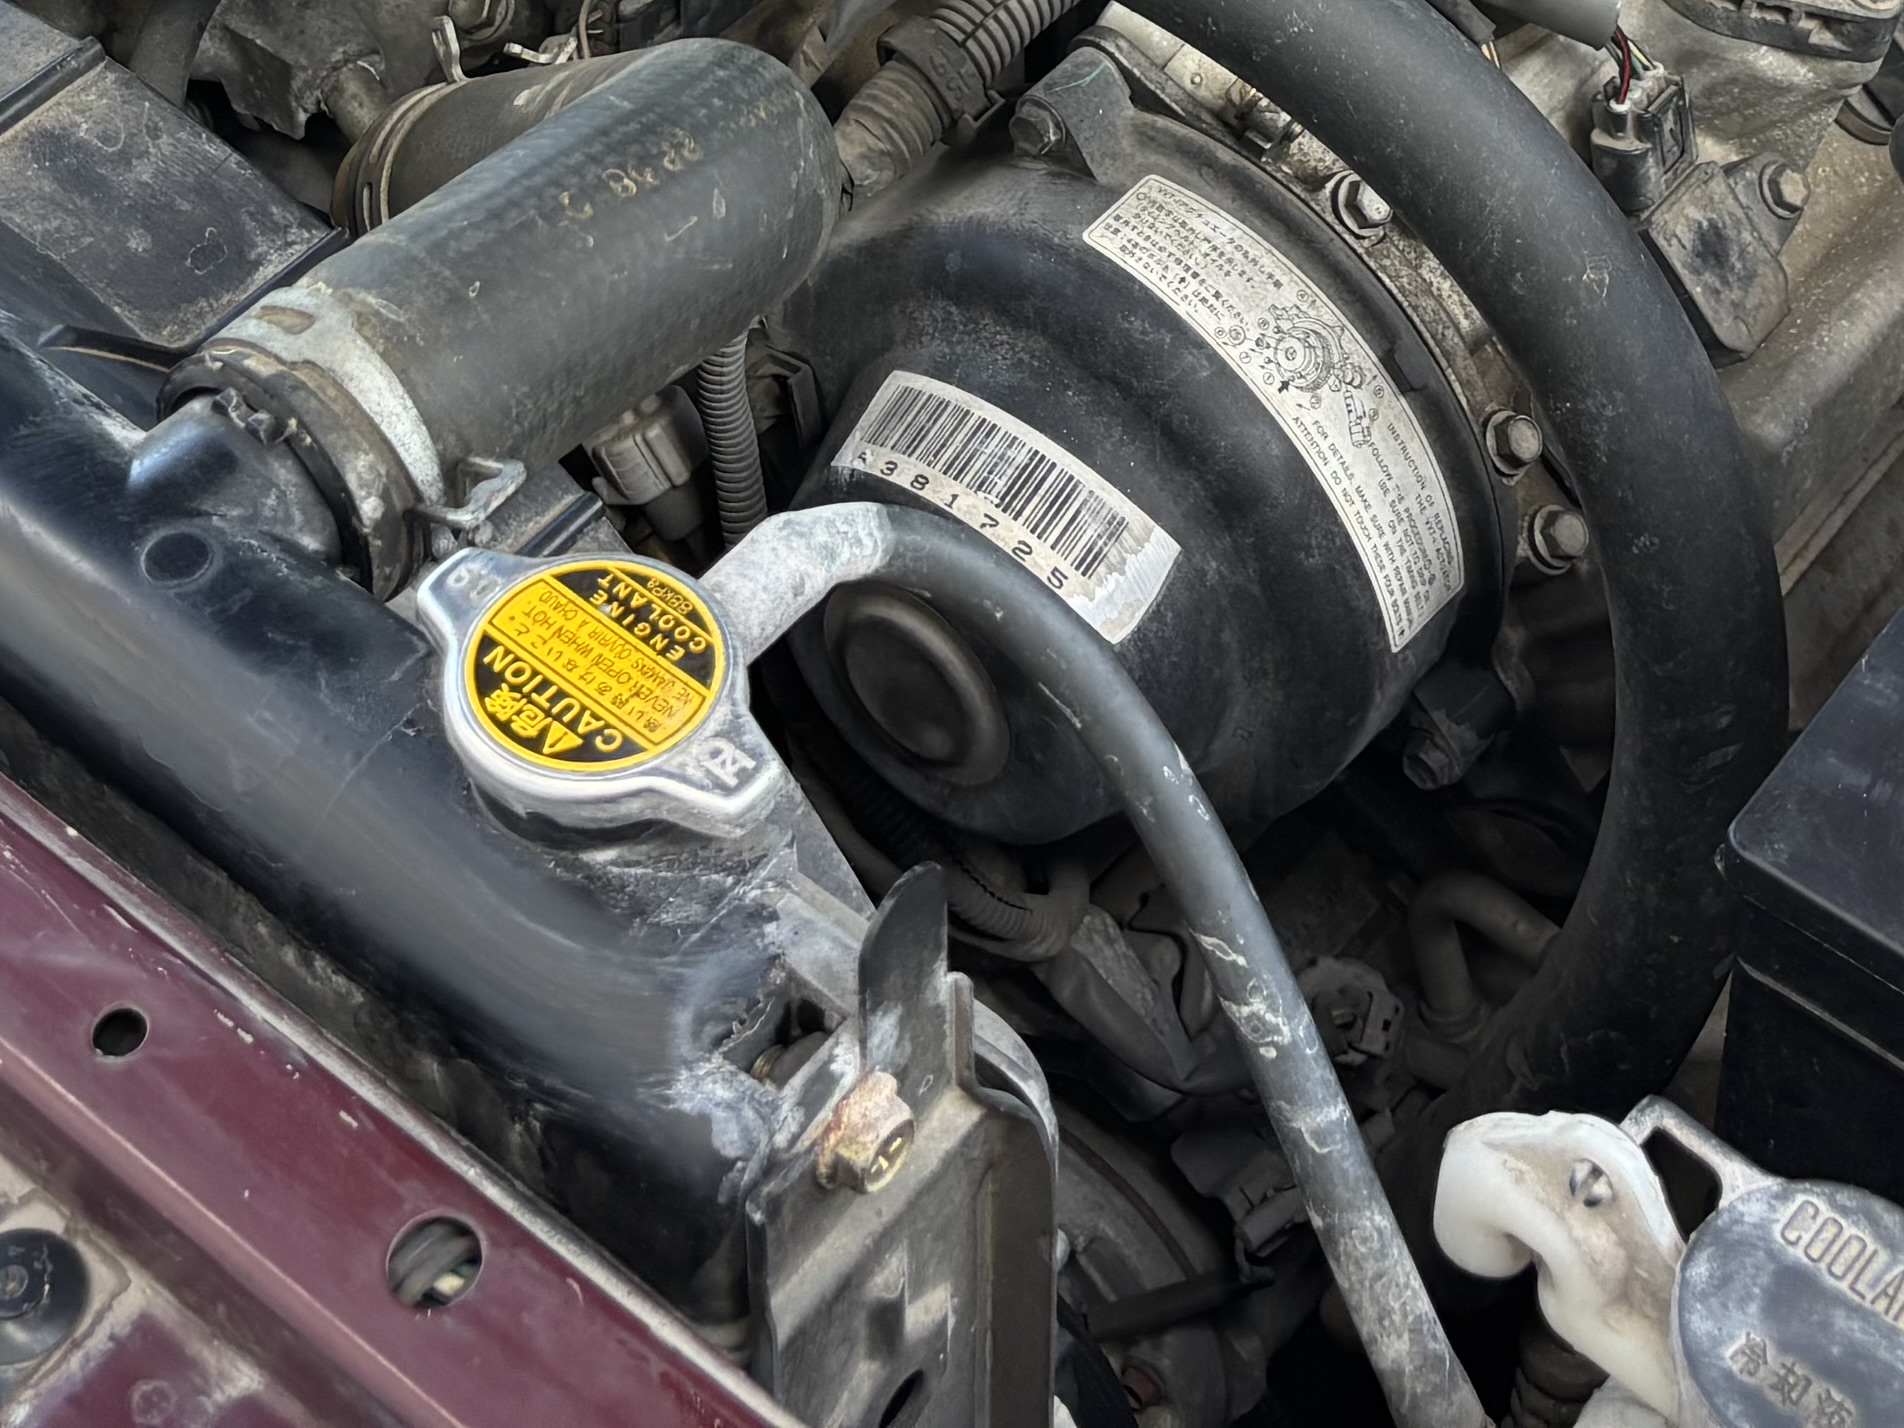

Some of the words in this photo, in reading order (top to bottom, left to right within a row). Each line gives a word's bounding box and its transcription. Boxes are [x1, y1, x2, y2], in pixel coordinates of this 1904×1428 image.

[1311, 420, 1328, 442] FOR
[1355, 485, 1372, 514] MAKE
[1370, 514, 1386, 541] SURE
[1368, 441, 1394, 483] FOLLOW
[1387, 422, 1426, 491] INSTRUCTION
[1330, 470, 1342, 486] DO
[1341, 487, 1355, 509] NOT
[1353, 510, 1372, 543] TOUCH
[1389, 500, 1404, 528] SURE
[554, 625, 594, 657] WHEN
[589, 589, 686, 661] ENGINE
[597, 572, 707, 654] COOLANT
[483, 645, 624, 753] CAUTION
[594, 653, 632, 685] OPEN
[630, 684, 677, 718] NEVER
